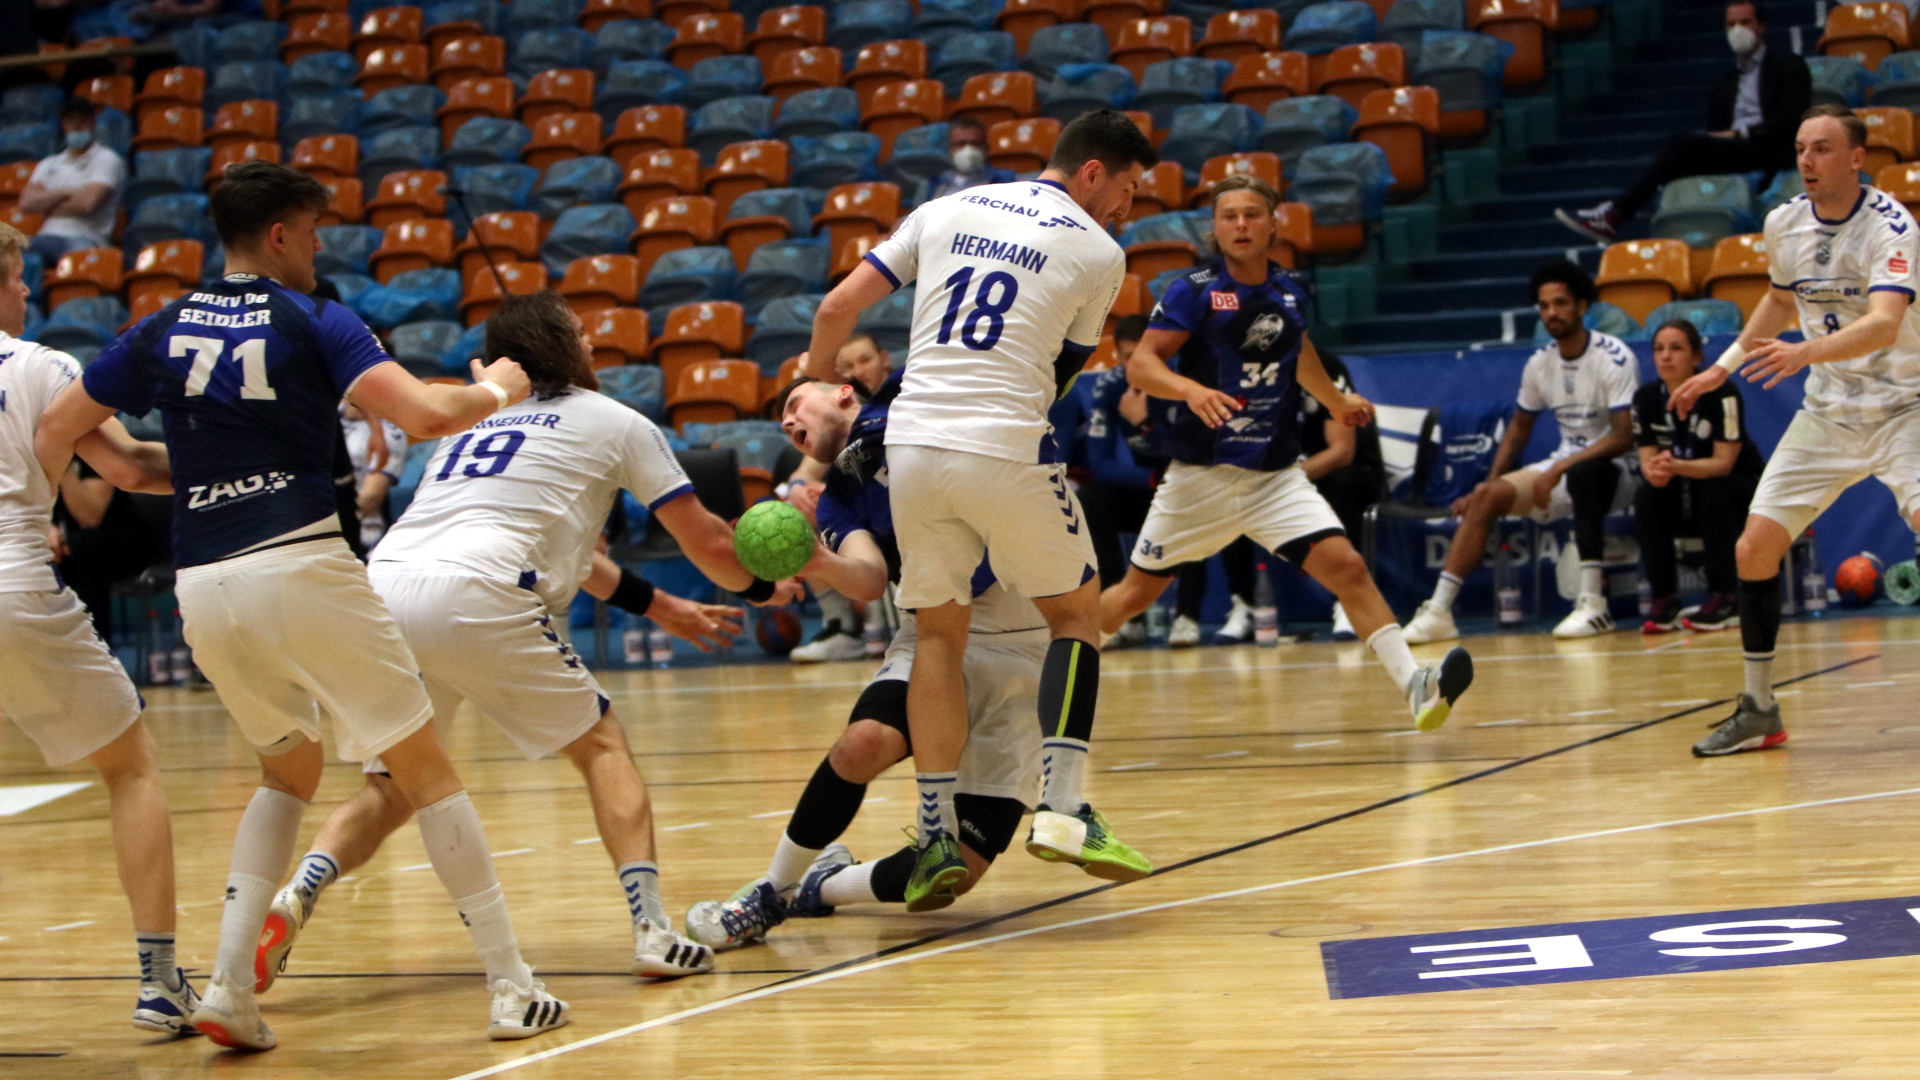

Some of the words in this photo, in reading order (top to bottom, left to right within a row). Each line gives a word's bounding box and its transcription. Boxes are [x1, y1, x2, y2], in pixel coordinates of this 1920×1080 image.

[961, 195, 1041, 218] FERCHAU
[951, 233, 1048, 274] HERMANN
[936, 265, 1019, 351] 18
[1212, 293, 1238, 309] DB
[178, 308, 271, 329] SEIDLER
[168, 334, 277, 401] 71
[1239, 362, 1280, 388] 34
[470, 412, 561, 432] HNEIDER
[436, 430, 526, 482] 19
[188, 475, 265, 509] ZAG
[1140, 539, 1164, 560] 34
[1425, 532, 1562, 569] DSSA
[1409, 908, 1920, 980] SE
